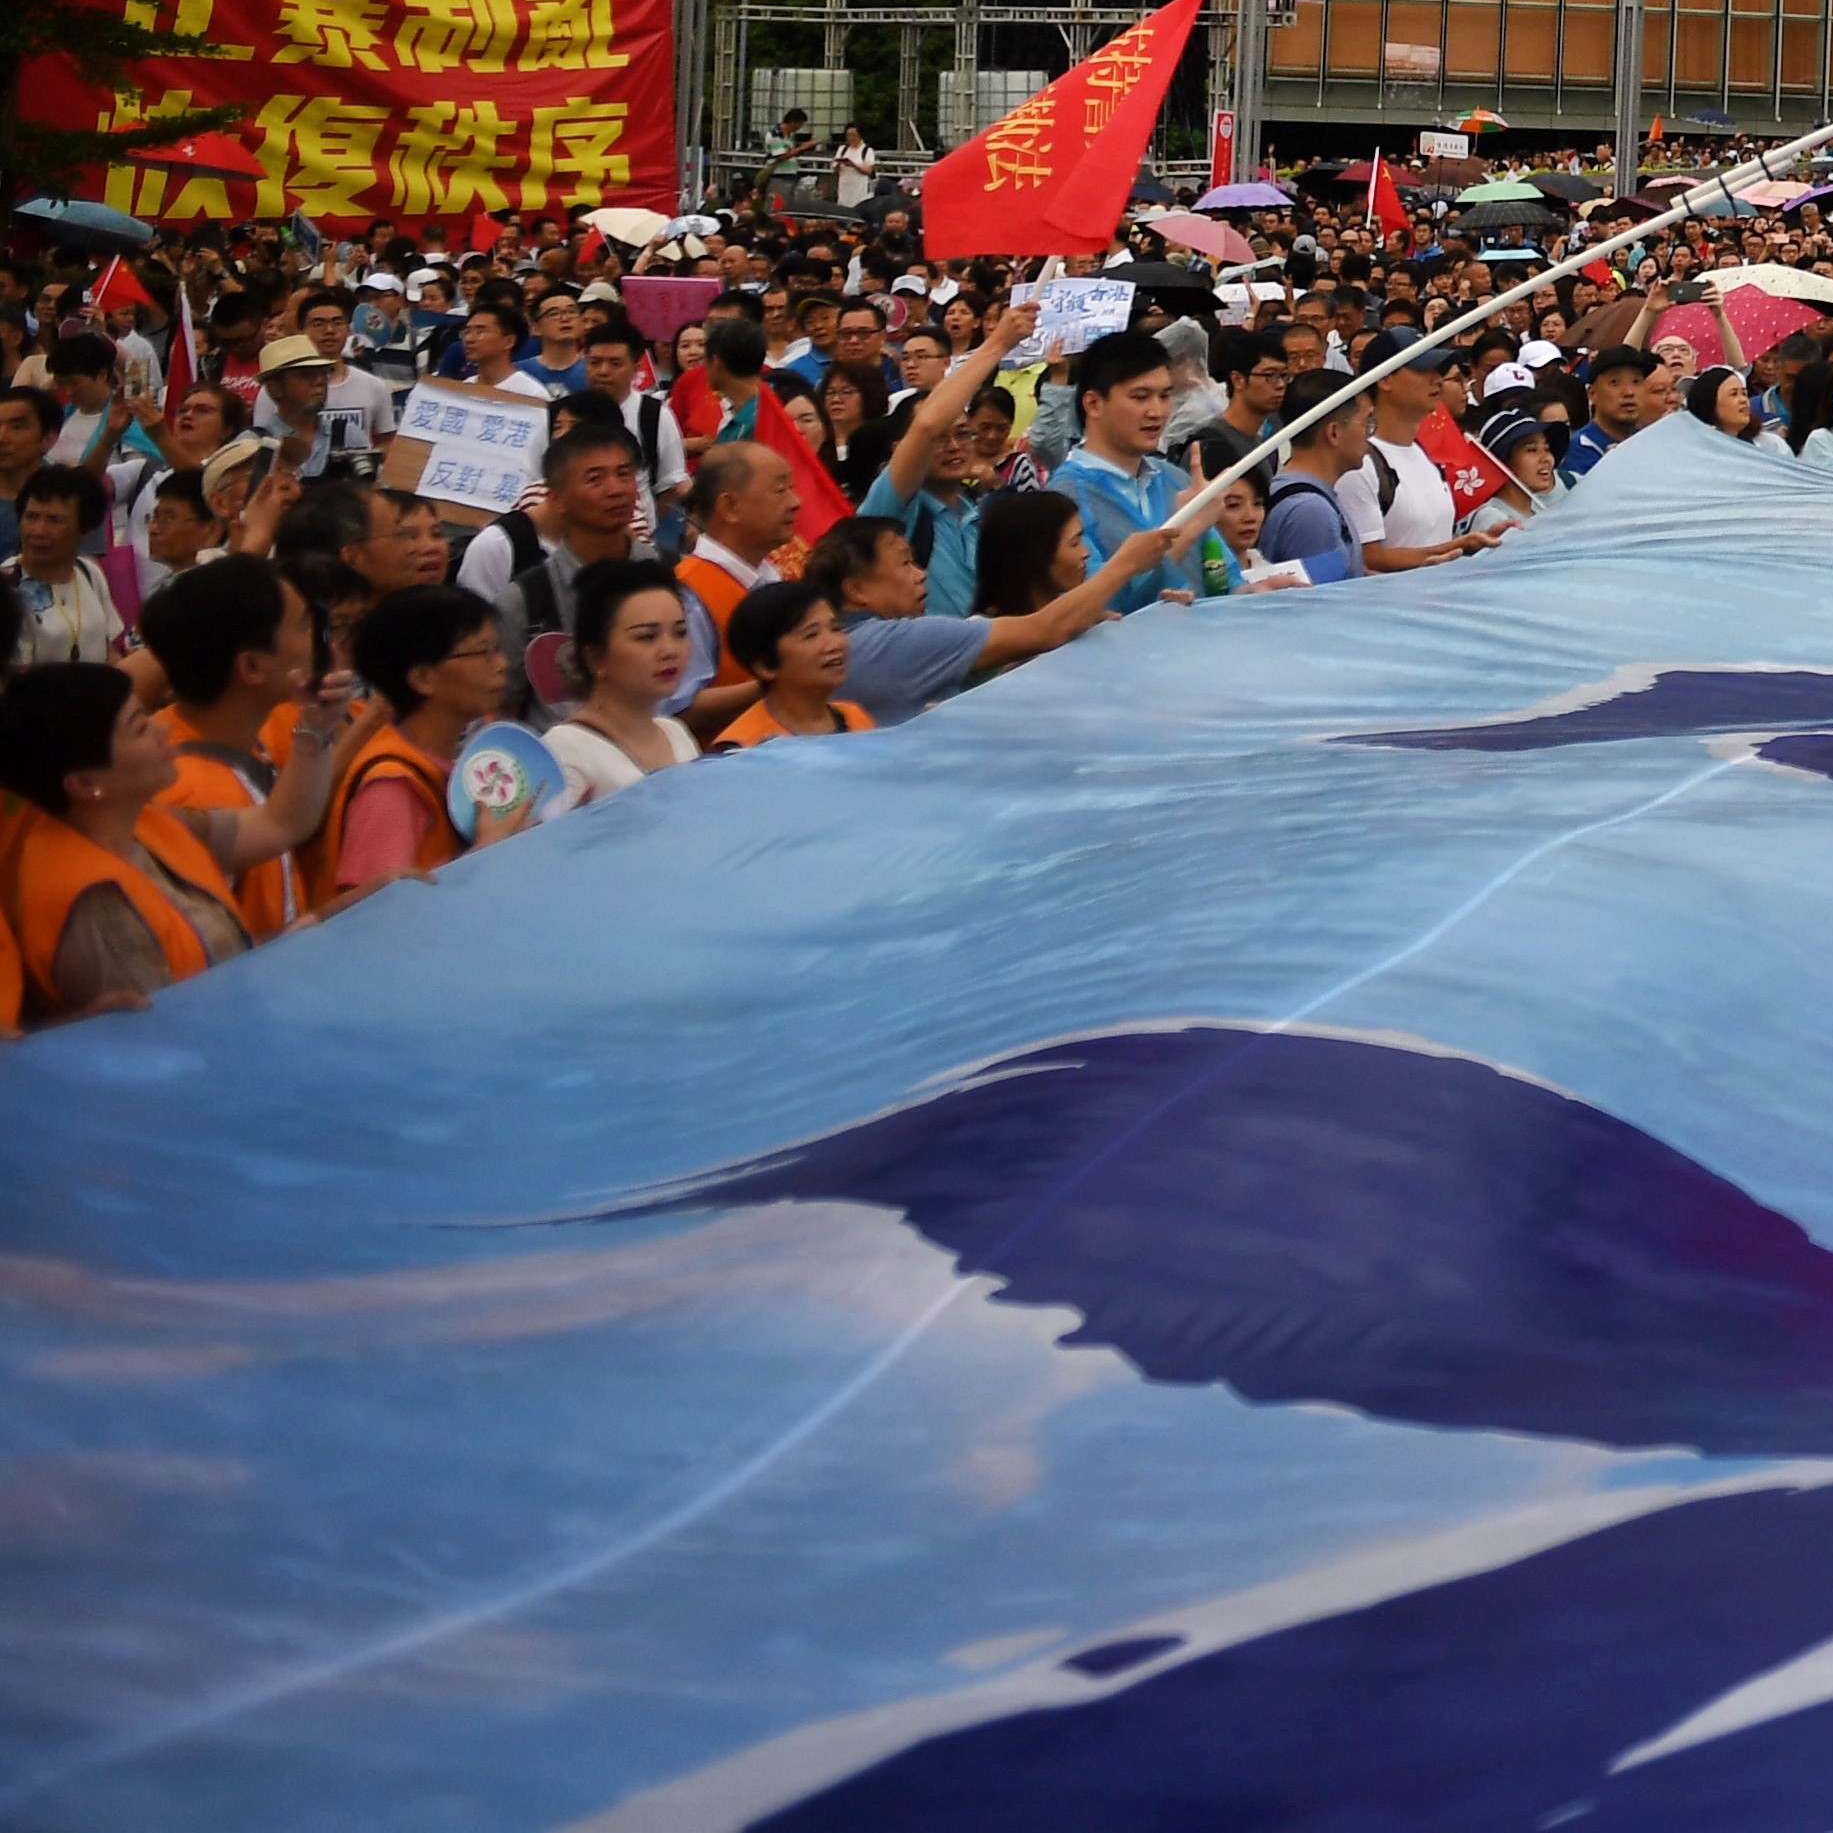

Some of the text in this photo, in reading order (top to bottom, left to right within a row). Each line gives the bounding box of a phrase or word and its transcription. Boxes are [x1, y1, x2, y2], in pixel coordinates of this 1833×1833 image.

[410, 400, 535, 448] 愛國 愛港
[427, 460, 483, 495] 反對
